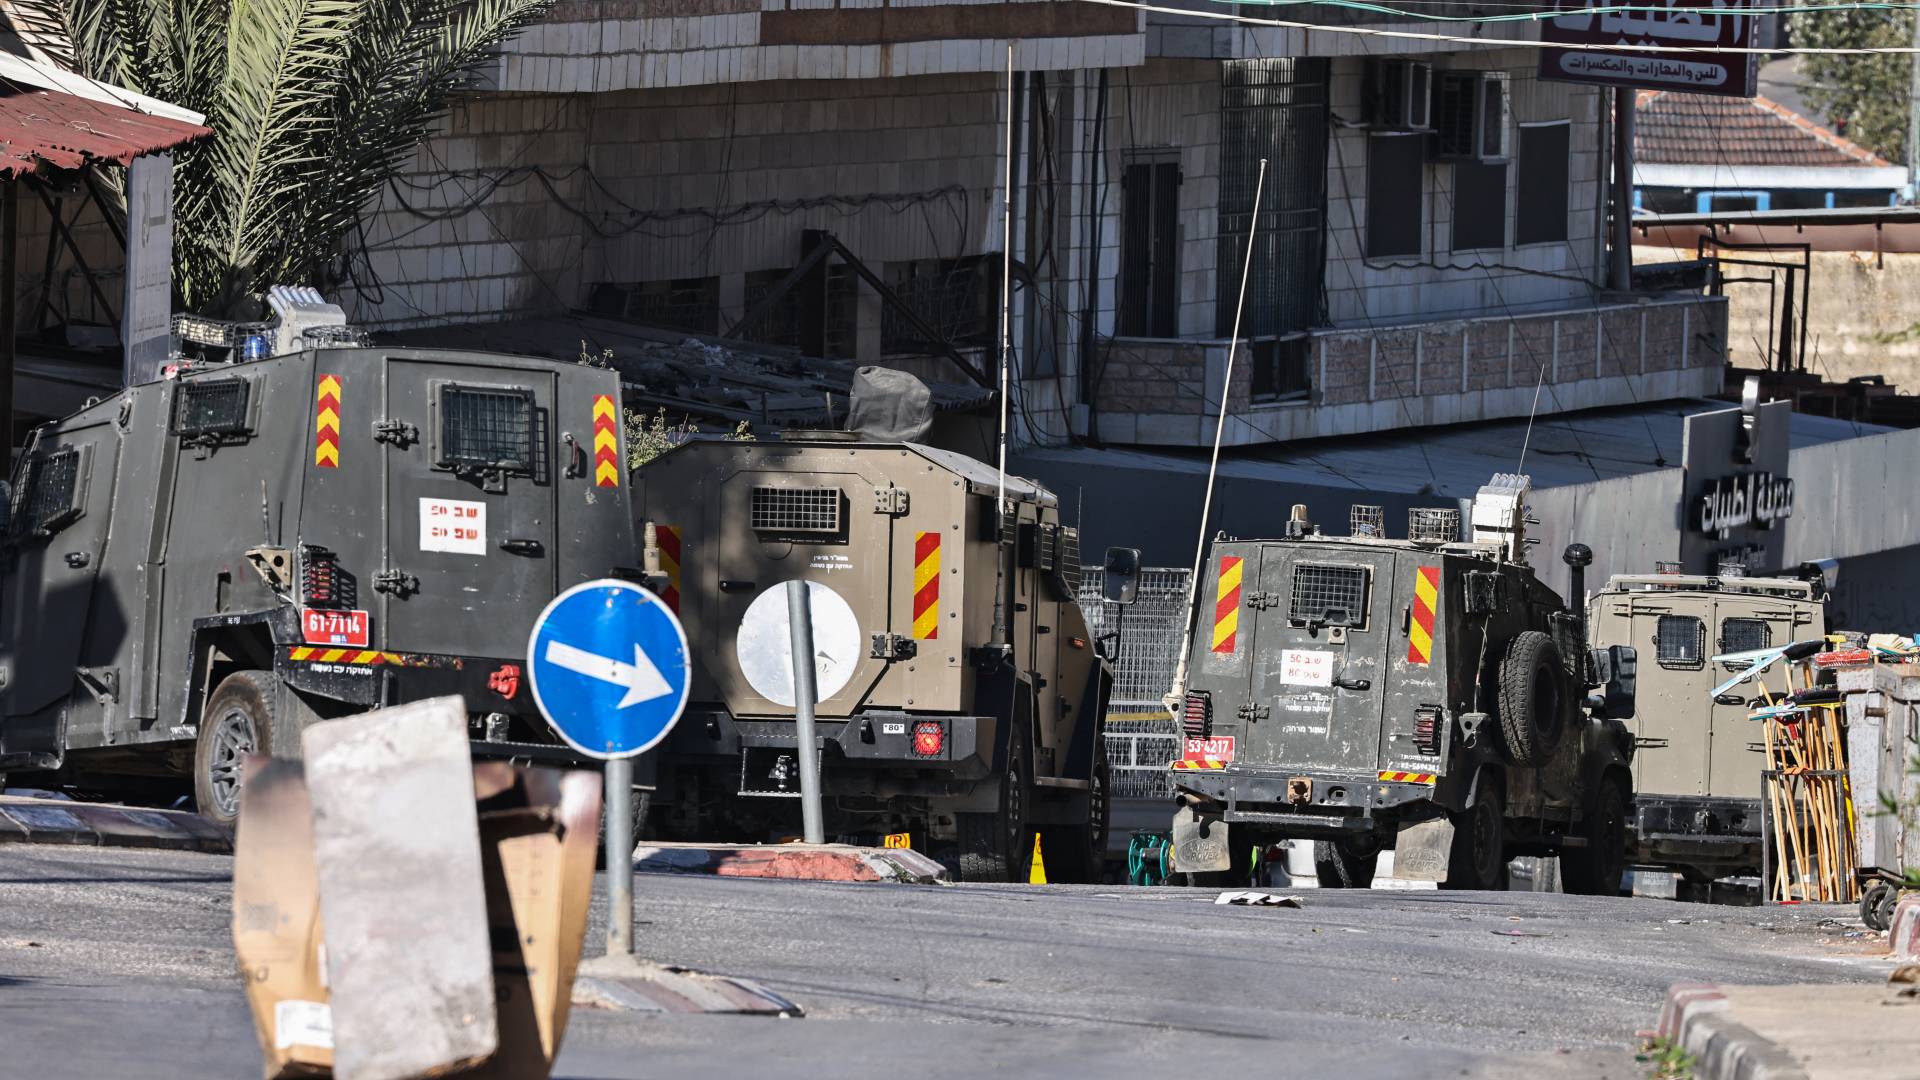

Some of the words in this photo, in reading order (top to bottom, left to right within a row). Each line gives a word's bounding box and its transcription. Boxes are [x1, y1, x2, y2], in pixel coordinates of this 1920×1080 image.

[1569, 57, 1634, 76] والمكسرات
[1702, 472, 1754, 539] الطيبات
[1756, 472, 1793, 530] مدينة
[333, 665, 345, 673] עם
